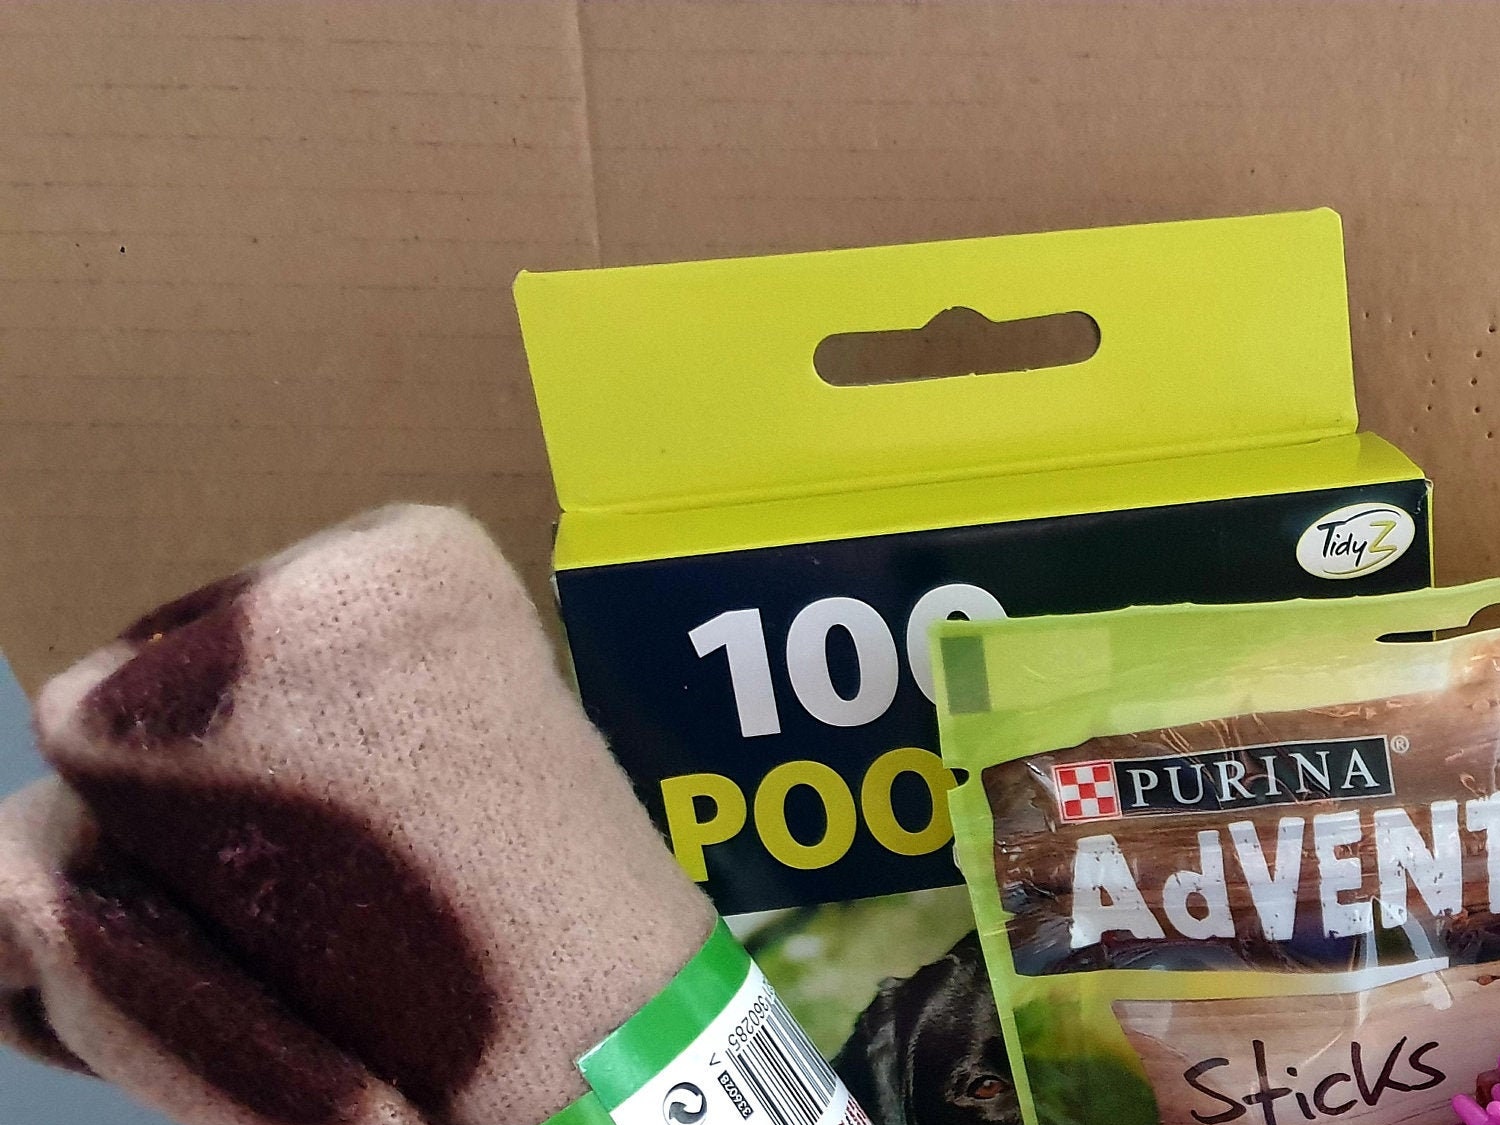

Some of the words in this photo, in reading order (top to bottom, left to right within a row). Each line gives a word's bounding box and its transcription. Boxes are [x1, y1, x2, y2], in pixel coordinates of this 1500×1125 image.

[1130, 753, 1379, 808] PURINA
[660, 747, 958, 882] POO
[719, 1073, 752, 1119] 336028
